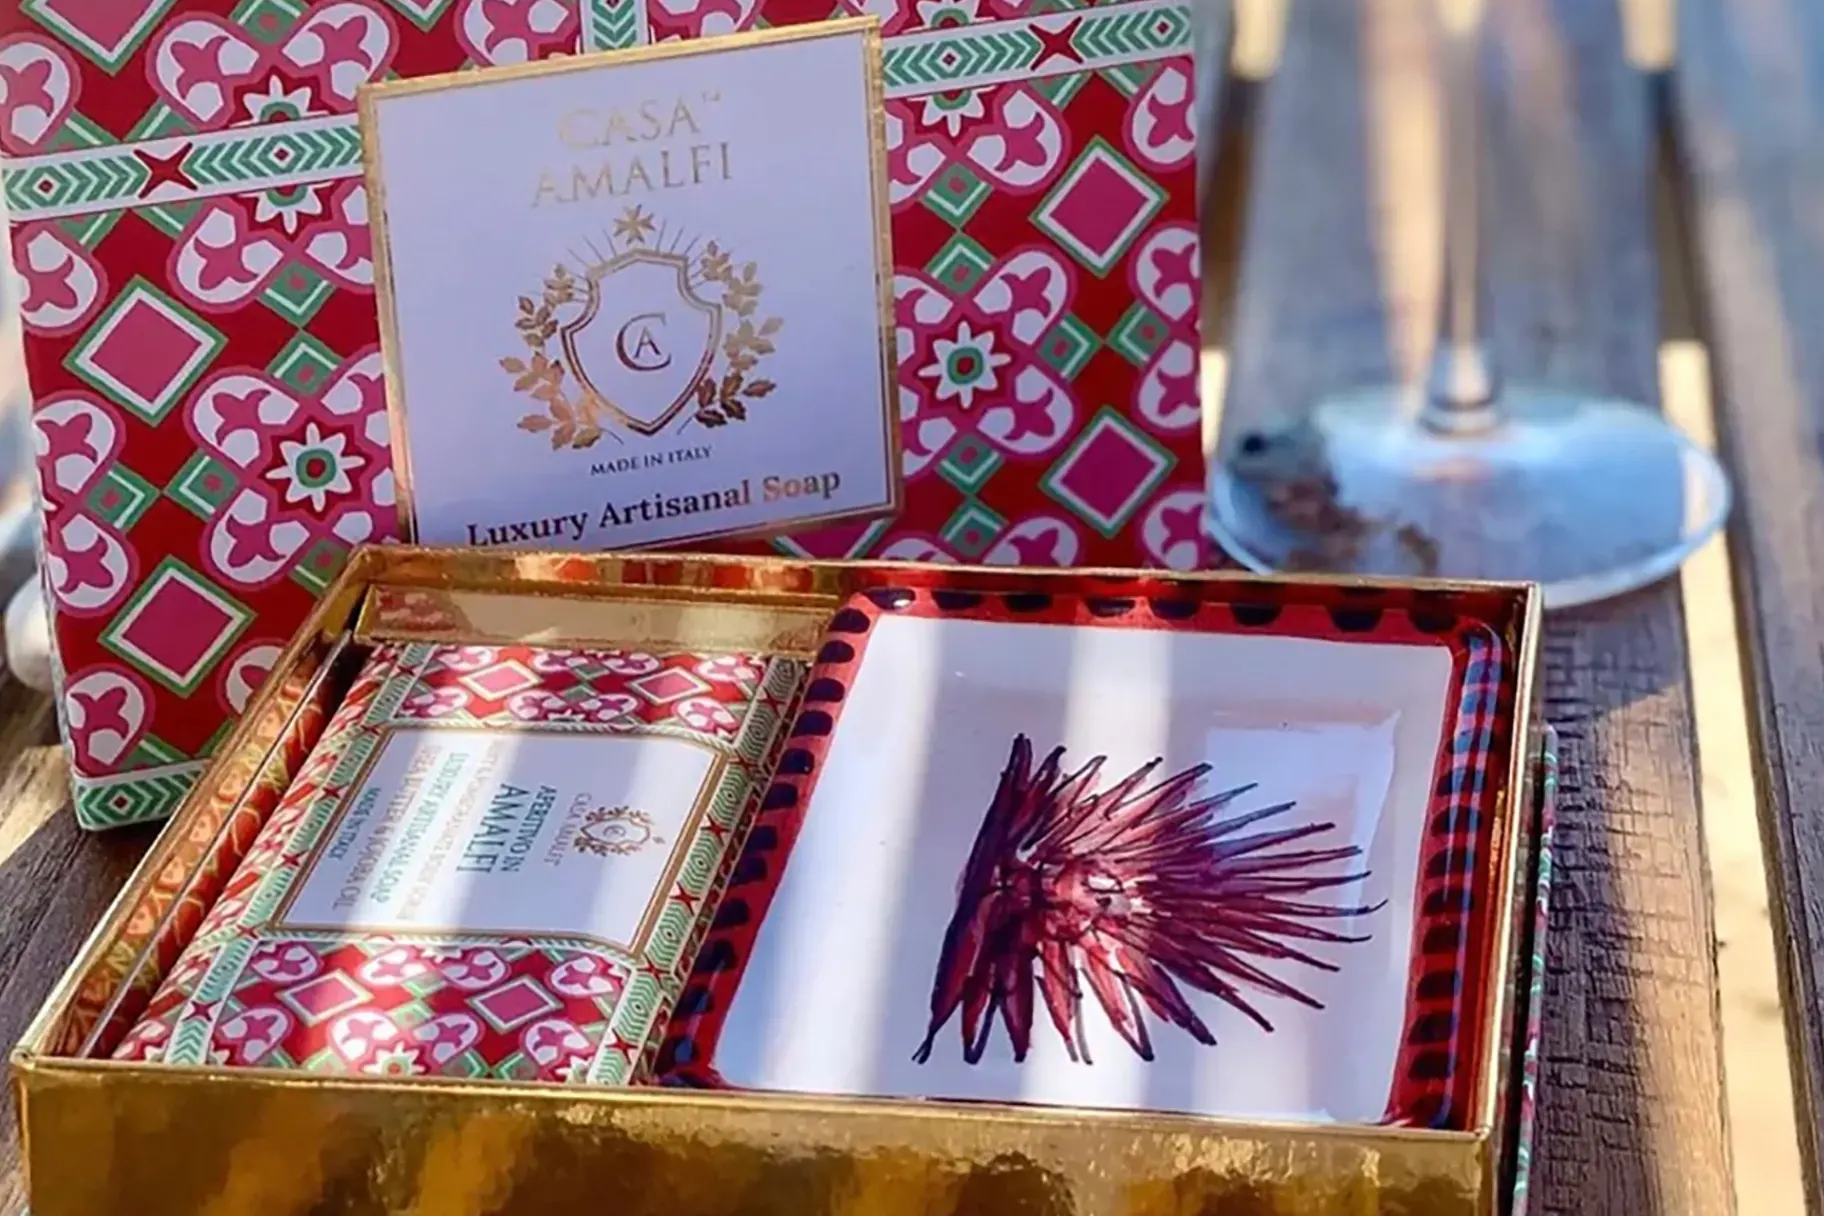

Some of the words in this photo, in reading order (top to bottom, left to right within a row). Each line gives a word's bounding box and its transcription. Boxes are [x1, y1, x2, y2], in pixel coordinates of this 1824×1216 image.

[532, 141, 732, 209] AMALFI
[590, 455, 640, 476] MADE
[645, 451, 663, 467] IN
[668, 444, 713, 464] ITALY
[466, 510, 589, 547] Luxury
[600, 478, 751, 529] Artisanal
[762, 470, 841, 503] Soap
[387, 799, 440, 868] ARTISANAL
[455, 782, 531, 874] AMALFI
[509, 784, 558, 855] APERITIVO
[346, 836, 391, 884] JOJOBA
[369, 869, 402, 904] SOAP
[501, 855, 526, 873] IN
[331, 886, 361, 911] OIL
